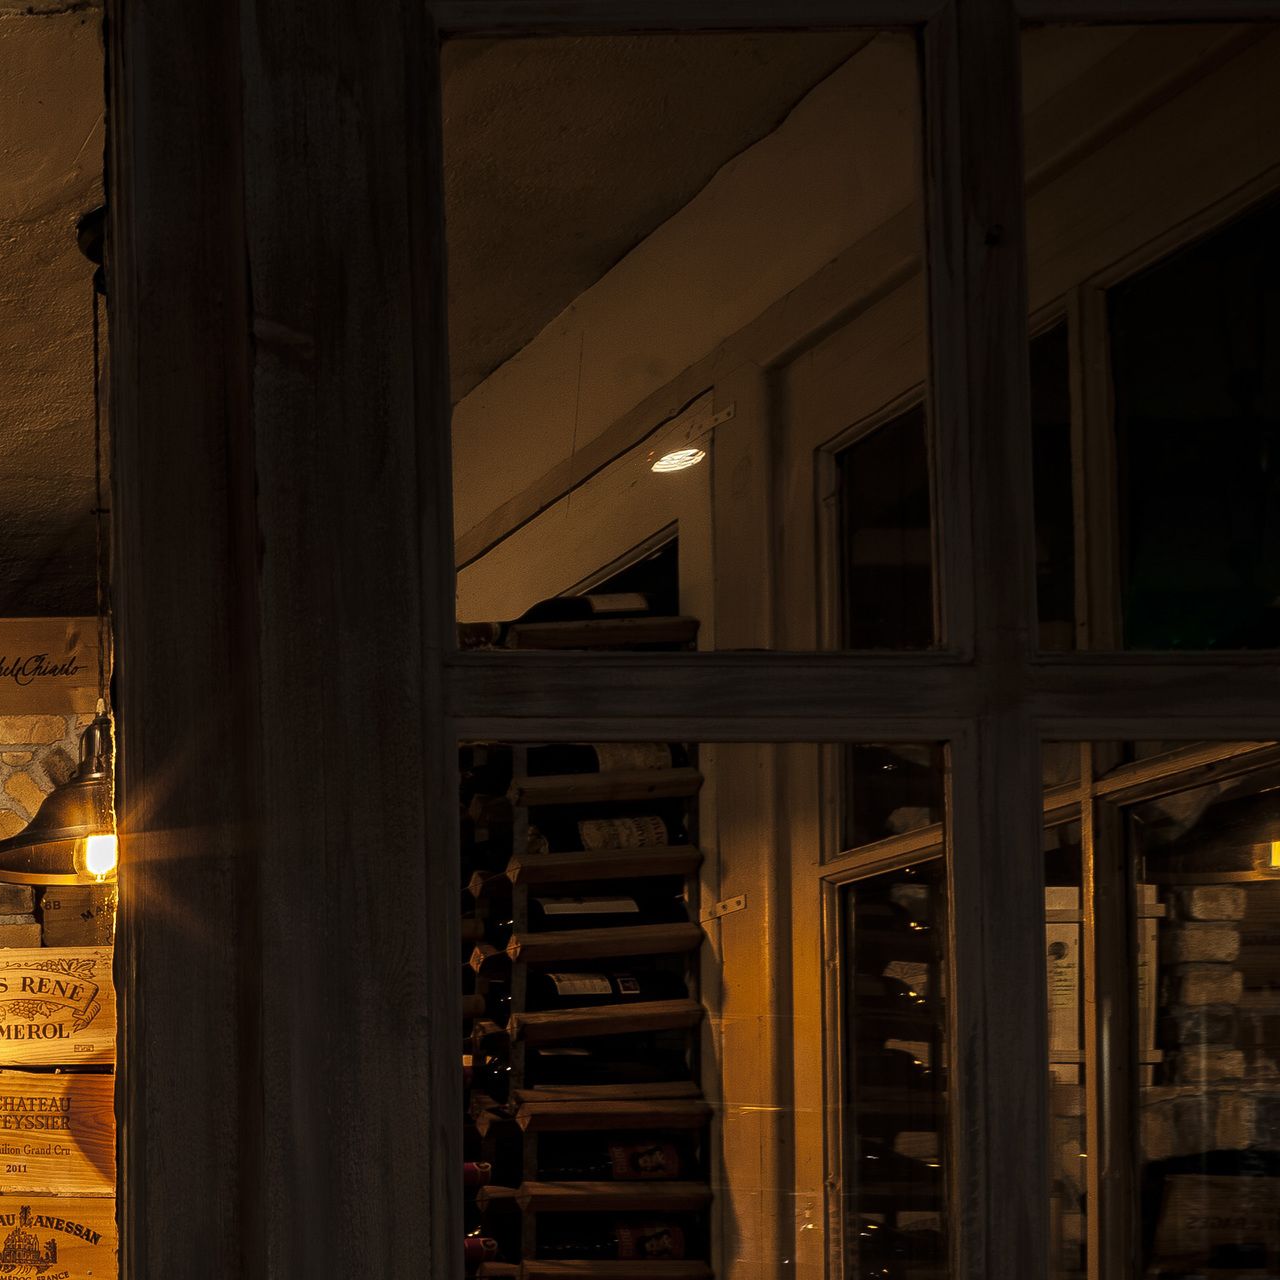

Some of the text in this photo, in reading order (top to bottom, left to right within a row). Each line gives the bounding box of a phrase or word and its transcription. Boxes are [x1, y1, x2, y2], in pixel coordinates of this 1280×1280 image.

[20, 653, 88, 680] Chiarlo
[21, 976, 84, 1002] RENÉ
[24, 1144, 51, 1155] Grand
[54, 1145, 70, 1155] Cru
[6, 1165, 27, 1173] 2011
[19, 1205, 103, 1246] LANESSAN
